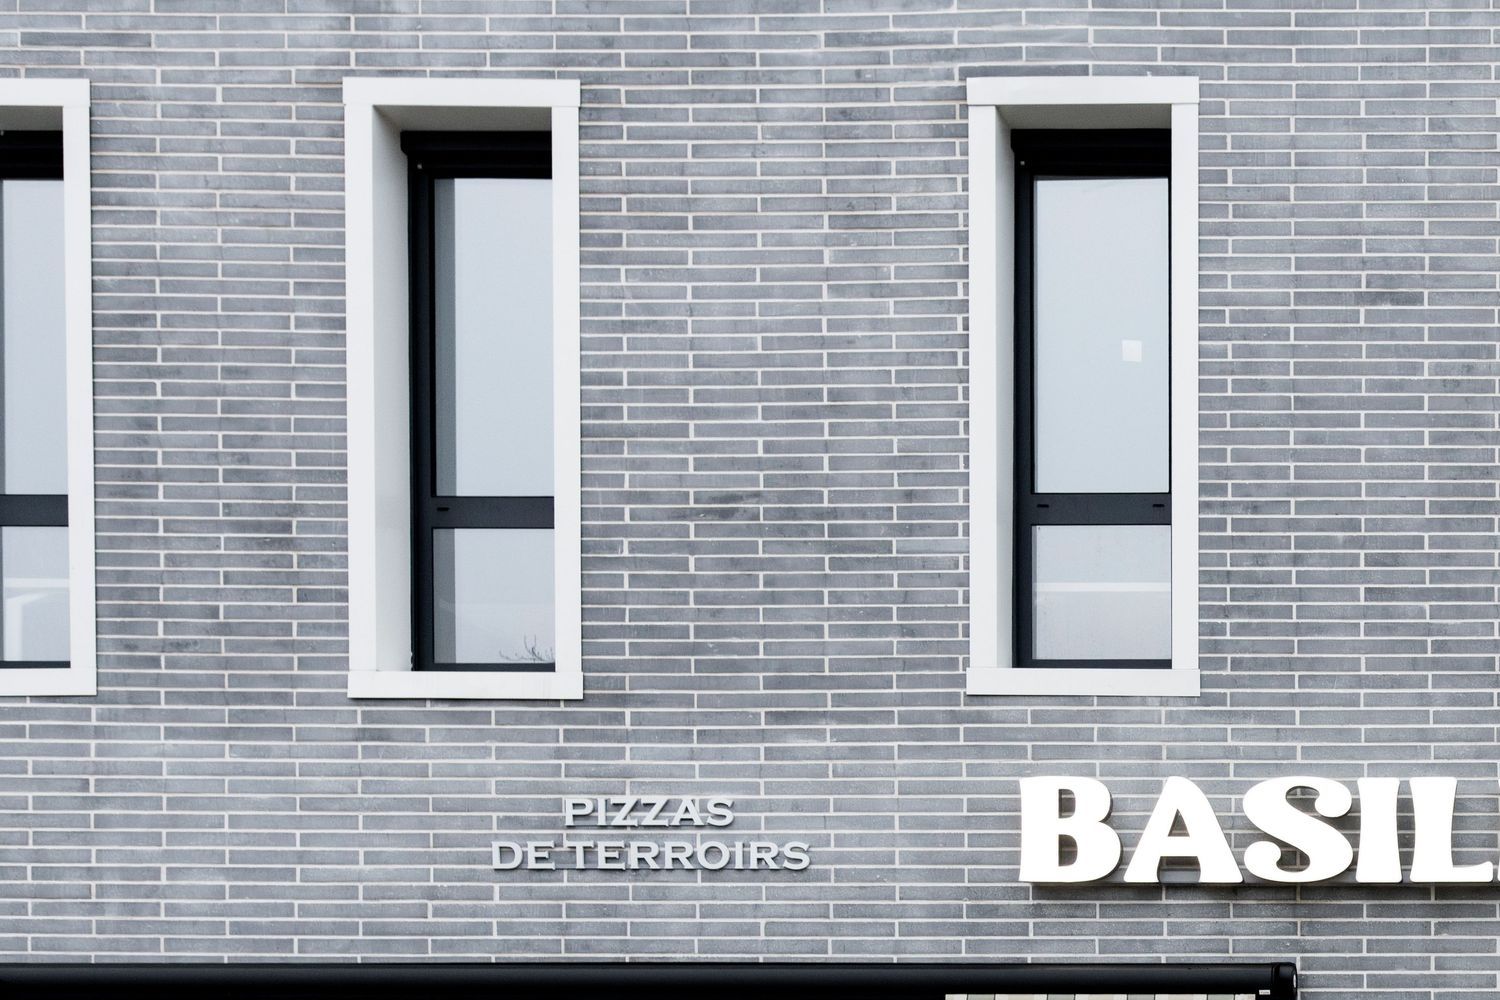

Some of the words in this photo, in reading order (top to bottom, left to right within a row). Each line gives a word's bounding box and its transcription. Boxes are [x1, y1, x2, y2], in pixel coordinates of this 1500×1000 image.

[564, 797, 735, 827] PIZZAS
[491, 840, 556, 871] DE
[565, 840, 811, 871] TERROIRS
